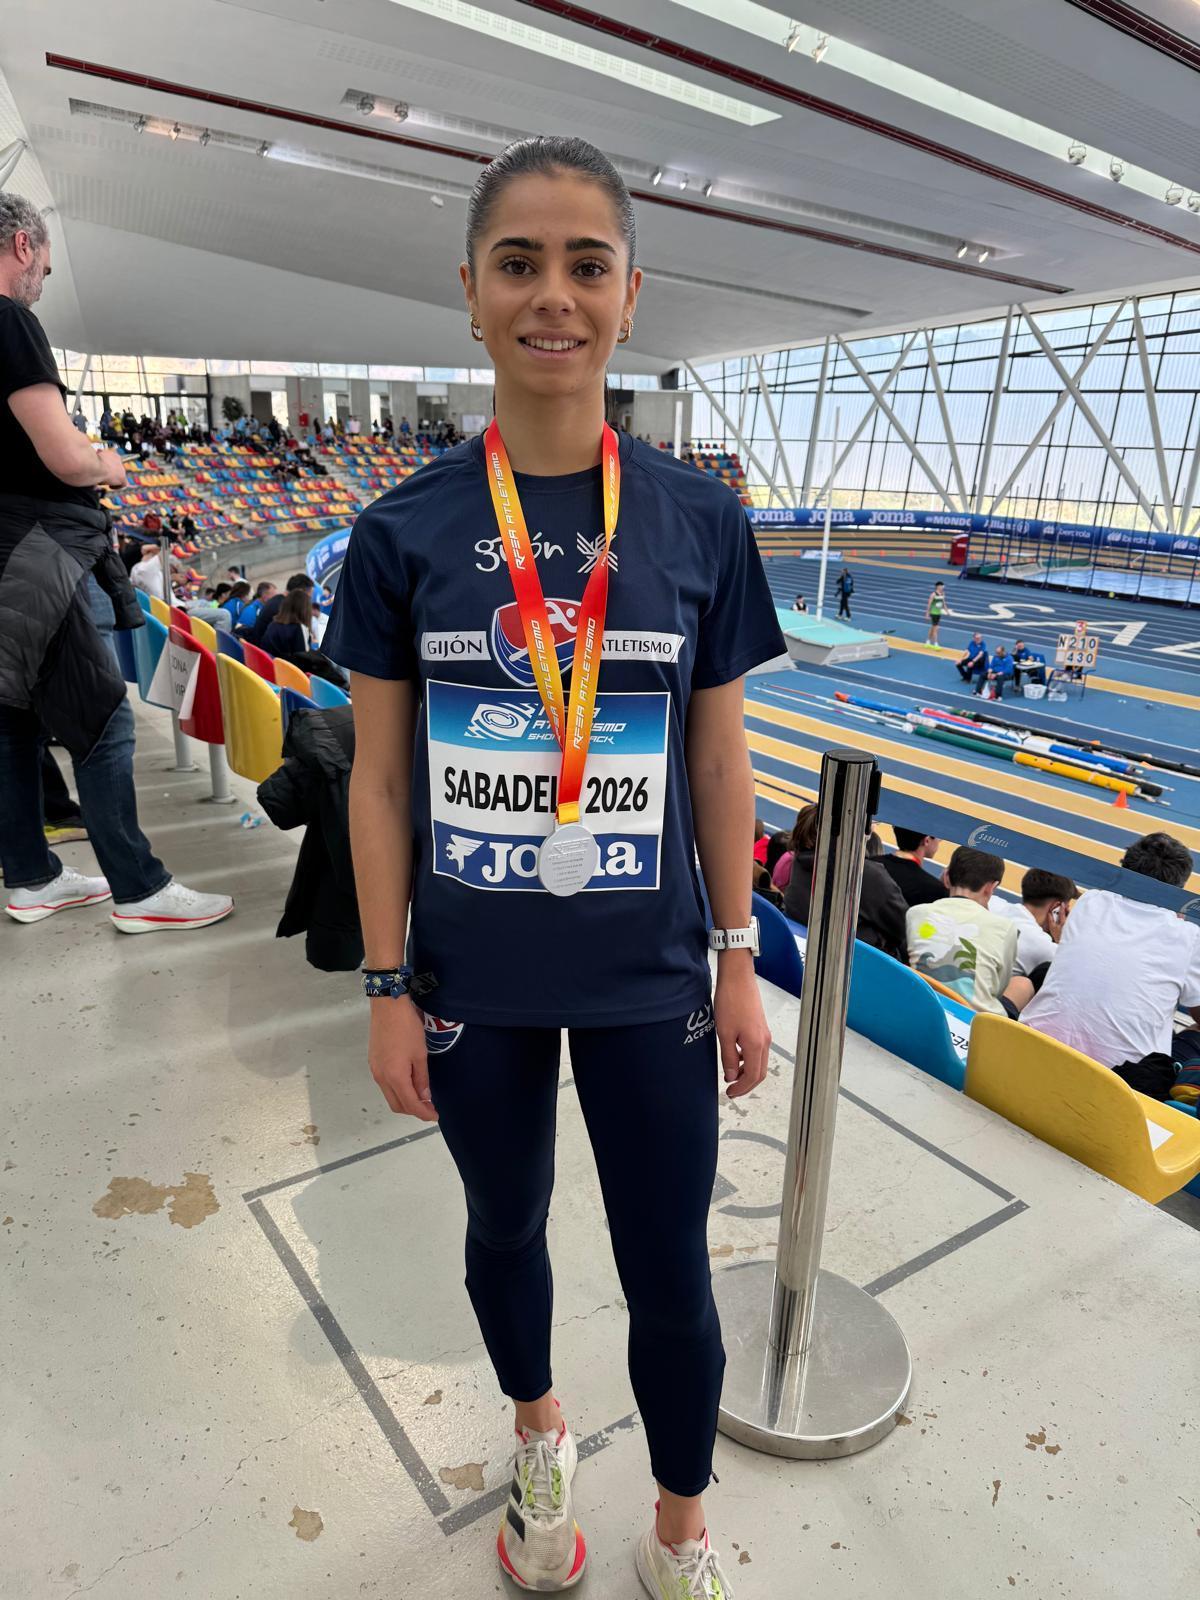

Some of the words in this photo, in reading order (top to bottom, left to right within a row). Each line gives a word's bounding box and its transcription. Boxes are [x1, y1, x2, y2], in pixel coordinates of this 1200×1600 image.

[491, 452, 514, 524] ATLETISMO
[751, 510, 796, 524] Joma
[868, 510, 916, 524] Joma
[475, 532, 564, 572] gón
[508, 529, 525, 570] RFEA
[172, 655, 188, 673] ONA
[427, 635, 483, 658] GIJÓN
[601, 638, 672, 655] TLETISMO
[531, 619, 554, 701] ATLETISMO
[1067, 652, 1094, 663] 430
[573, 706, 585, 750] RFEA
[579, 617, 596, 701] ATLETISMO
[532, 719, 627, 732] ATSMO
[444, 766, 558, 813] SABADEL
[585, 776, 648, 814] 2026
[481, 841, 643, 883] Joa
